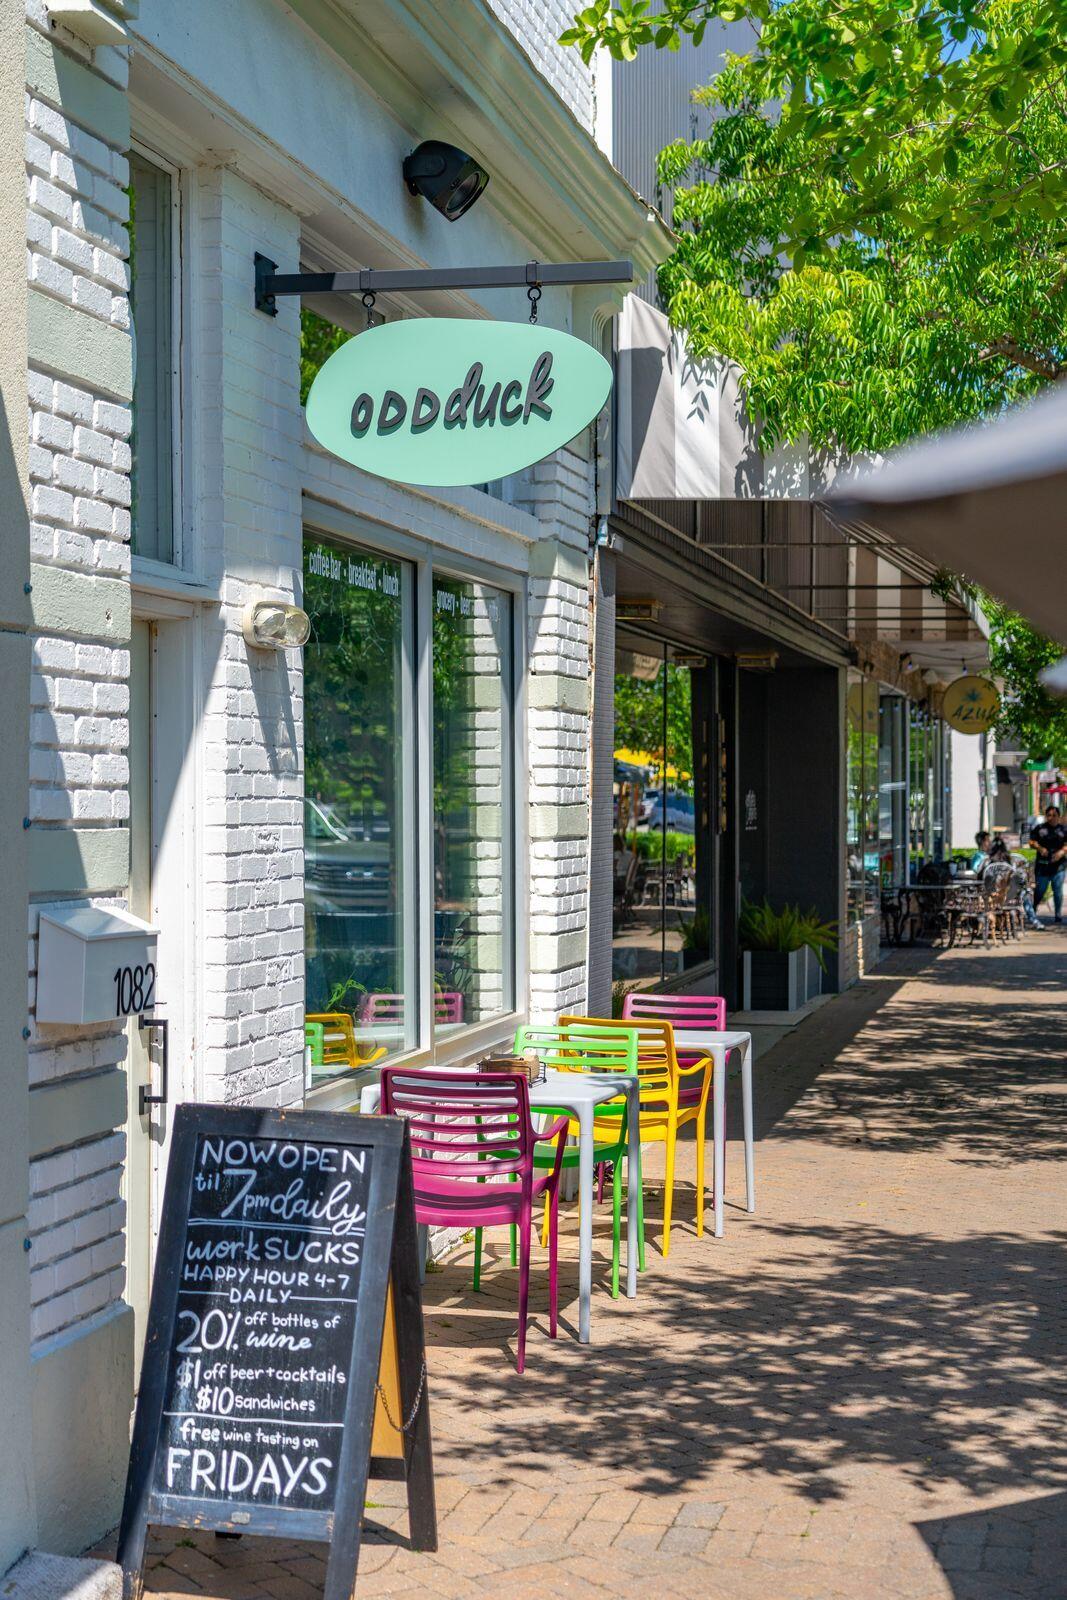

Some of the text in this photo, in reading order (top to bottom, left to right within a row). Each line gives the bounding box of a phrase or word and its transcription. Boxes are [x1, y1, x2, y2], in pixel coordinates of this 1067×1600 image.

[348, 557, 376, 591] breakfast
[383, 568, 398, 596] lunch
[114, 963, 155, 1016] 1082
[201, 1140, 365, 1173] NOW OPEN
[270, 1178, 366, 1236] daily
[187, 1231, 360, 1265] work SUCKS
[183, 1264, 350, 1290] HAPPY HOUR 4-7
[230, 1288, 291, 1303] DAILY
[244, 1311, 268, 1327] off
[272, 1313, 319, 1329] bottles
[324, 1314, 341, 1328] of
[245, 1327, 312, 1351] wine
[176, 1357, 201, 1389] $1
[203, 1363, 228, 1381] off
[195, 1386, 316, 1415] $10 sandwiches
[180, 1418, 319, 1450] free wine tasting on
[166, 1446, 333, 1498] FRIDAYS
